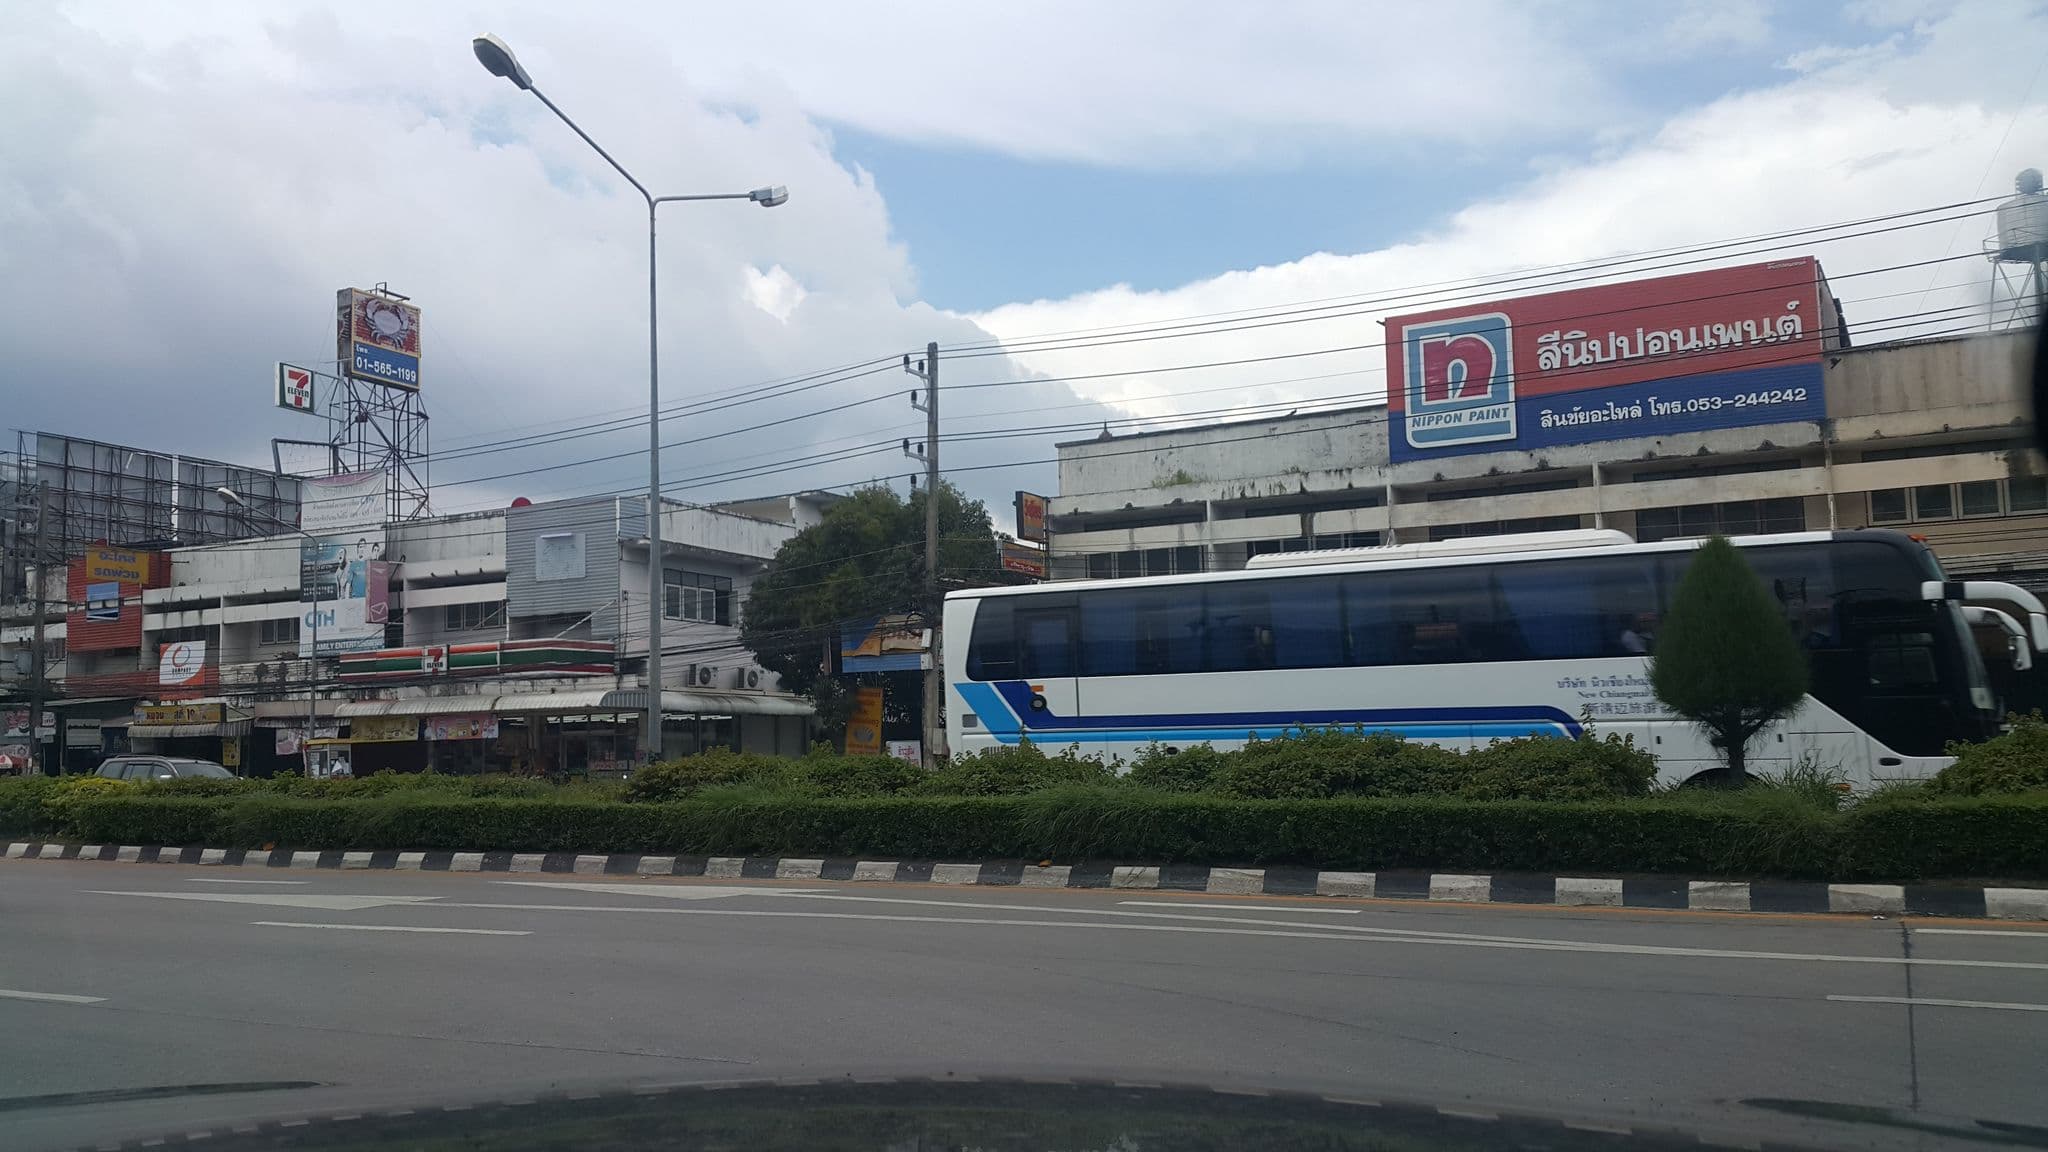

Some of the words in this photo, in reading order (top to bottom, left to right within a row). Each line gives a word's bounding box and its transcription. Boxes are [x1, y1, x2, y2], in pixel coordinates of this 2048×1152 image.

[1537, 300, 1804, 371] สีนิปปอนเพนต์
[356, 356, 417, 382] 01-565-1199
[287, 386, 310, 398] ELEVEN
[288, 369, 309, 407] 7
[1412, 413, 1463, 428] NIPPON
[1469, 407, 1510, 421] PAINT
[428, 648, 443, 673] 7
